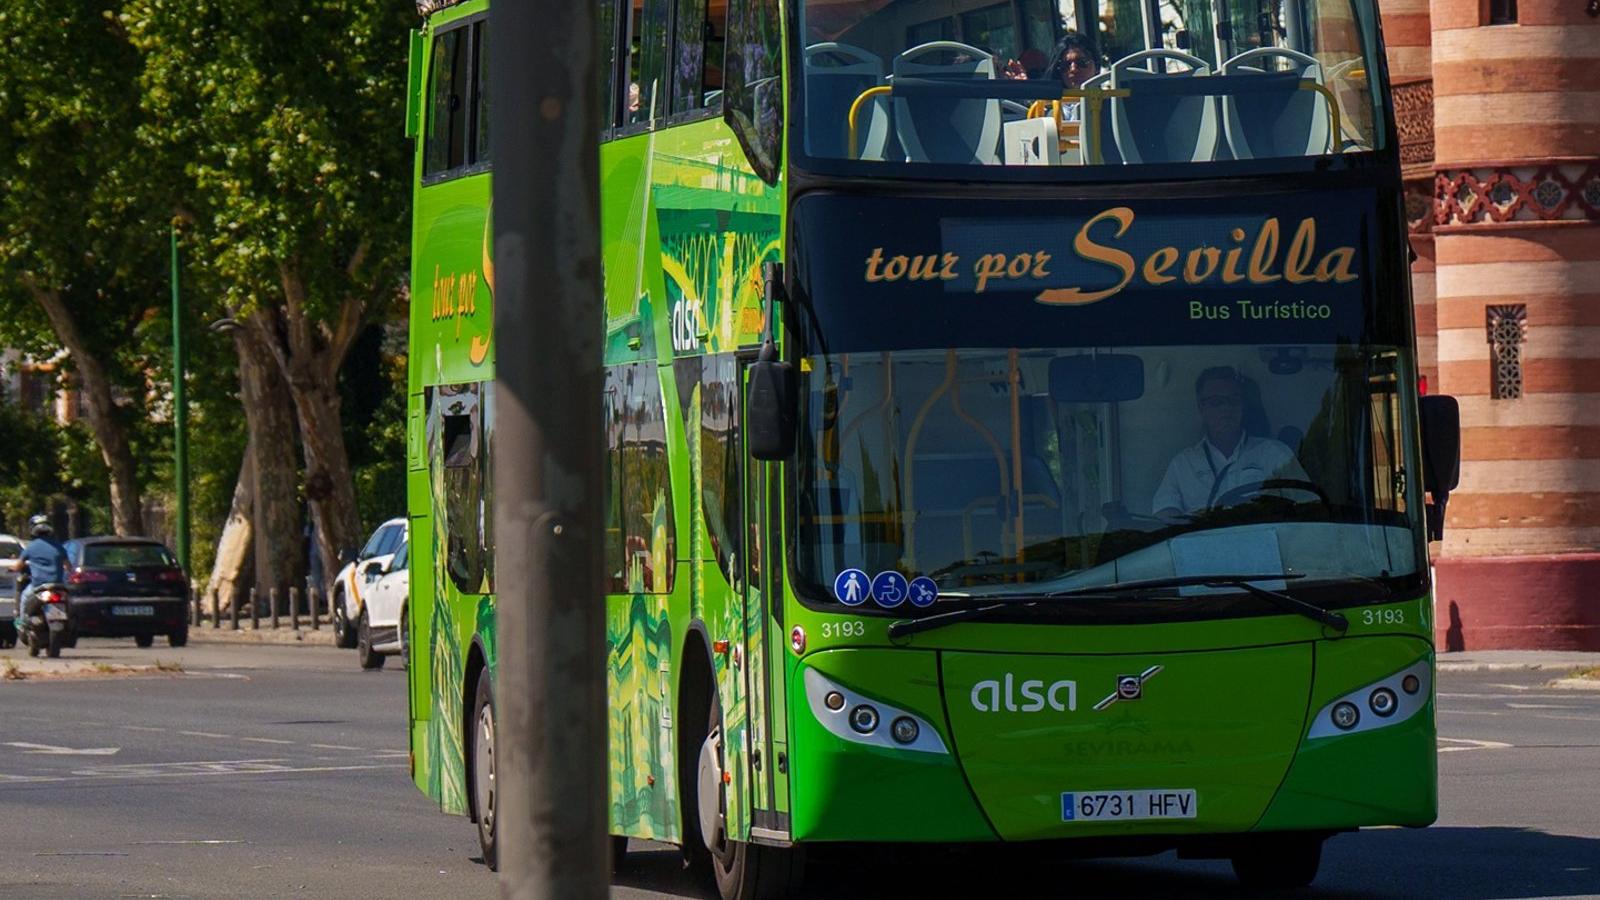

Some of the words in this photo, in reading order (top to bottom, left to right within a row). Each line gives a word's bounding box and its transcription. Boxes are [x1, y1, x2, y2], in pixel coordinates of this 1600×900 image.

[865, 247, 959, 281] tour
[974, 250, 1051, 293] por
[1035, 206, 1358, 306] Sevilla
[1189, 300, 1230, 319] Bus
[1237, 300, 1331, 319] Turístico
[672, 289, 700, 351] alsa
[1362, 608, 1404, 625] 3193
[821, 621, 865, 638] 3193
[971, 672, 1077, 712] alsa
[1063, 739, 1194, 757] SEVIRAMA
[1081, 795, 1134, 816] 6731
[1149, 794, 1190, 815] HFV
